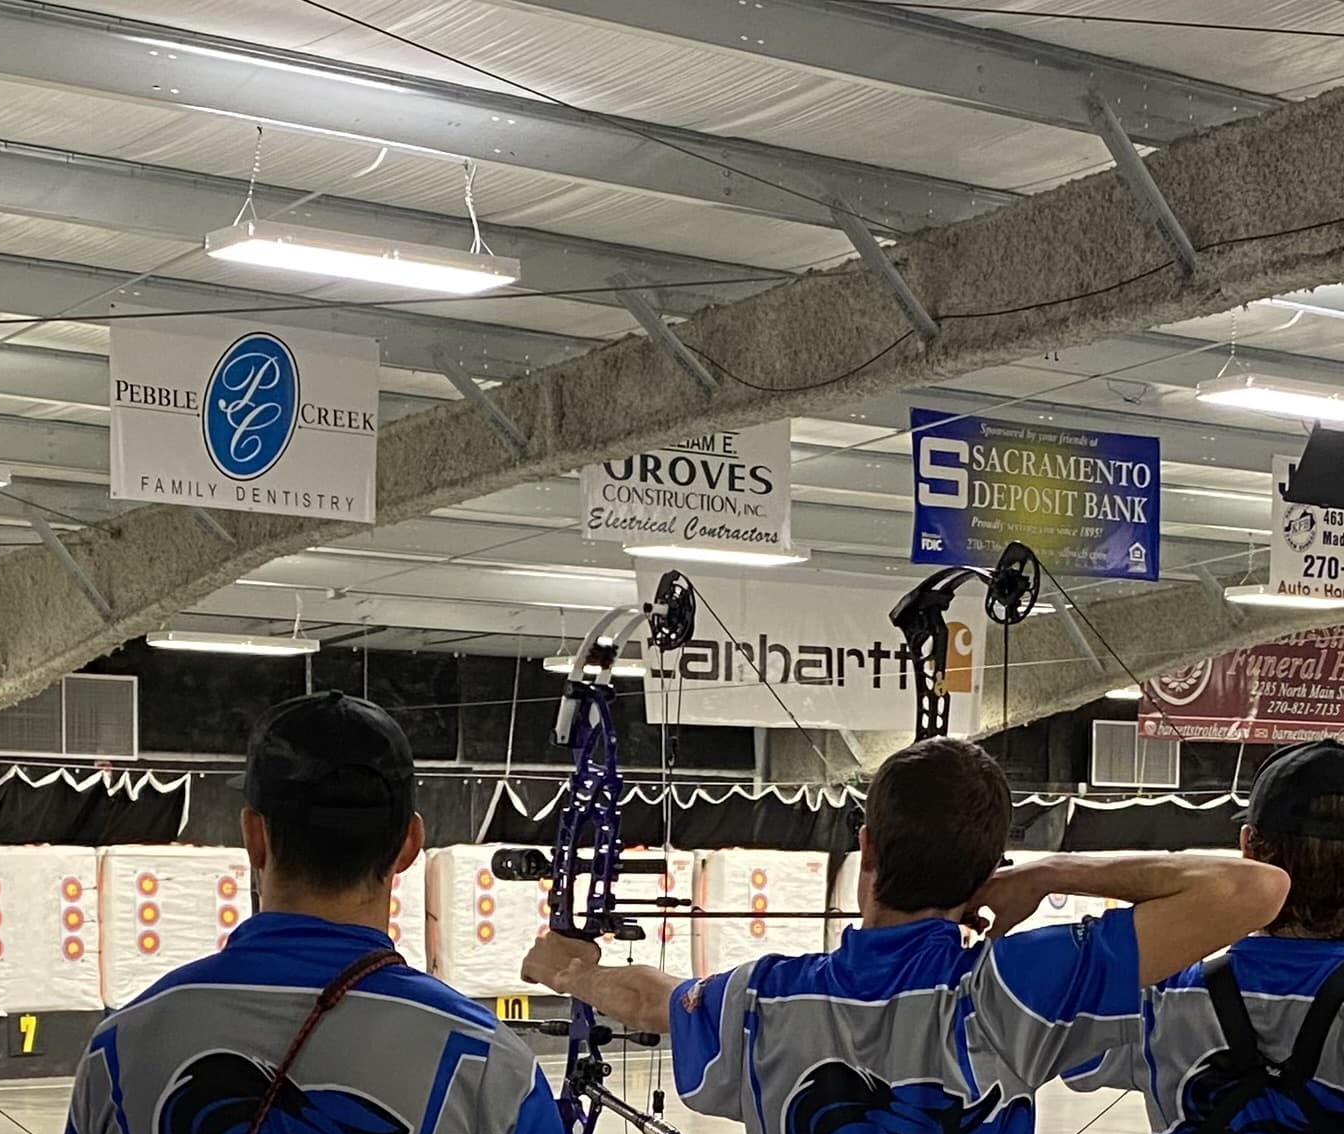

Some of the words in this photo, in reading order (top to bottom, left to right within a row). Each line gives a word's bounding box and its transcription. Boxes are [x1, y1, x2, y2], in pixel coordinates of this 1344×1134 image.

[114, 379, 199, 410] PEBBLE
[300, 402, 376, 432] CREEK
[722, 436, 738, 454] E.
[972, 444, 1152, 490] SACRAMENTO
[141, 475, 218, 498] FAMILY
[236, 486, 356, 513] DENTISTRY
[601, 483, 742, 517] CONSTRUCTION,
[971, 480, 1079, 517] DEPOSIT
[1083, 491, 1149, 525] BANK
[587, 506, 677, 534] Electrical
[683, 515, 780, 544] Contractors
[1322, 510, 1344, 527] 463
[920, 538, 943, 552] FDIC
[1277, 579, 1311, 596] Auto
[1225, 647, 1329, 681] Funeral
[1250, 680, 1278, 698] 2285
[1277, 683, 1307, 699] North
[1308, 684, 1335, 701] Main
[1266, 700, 1342, 716] 270-821-7135
[19, 1015, 37, 1053] 7
